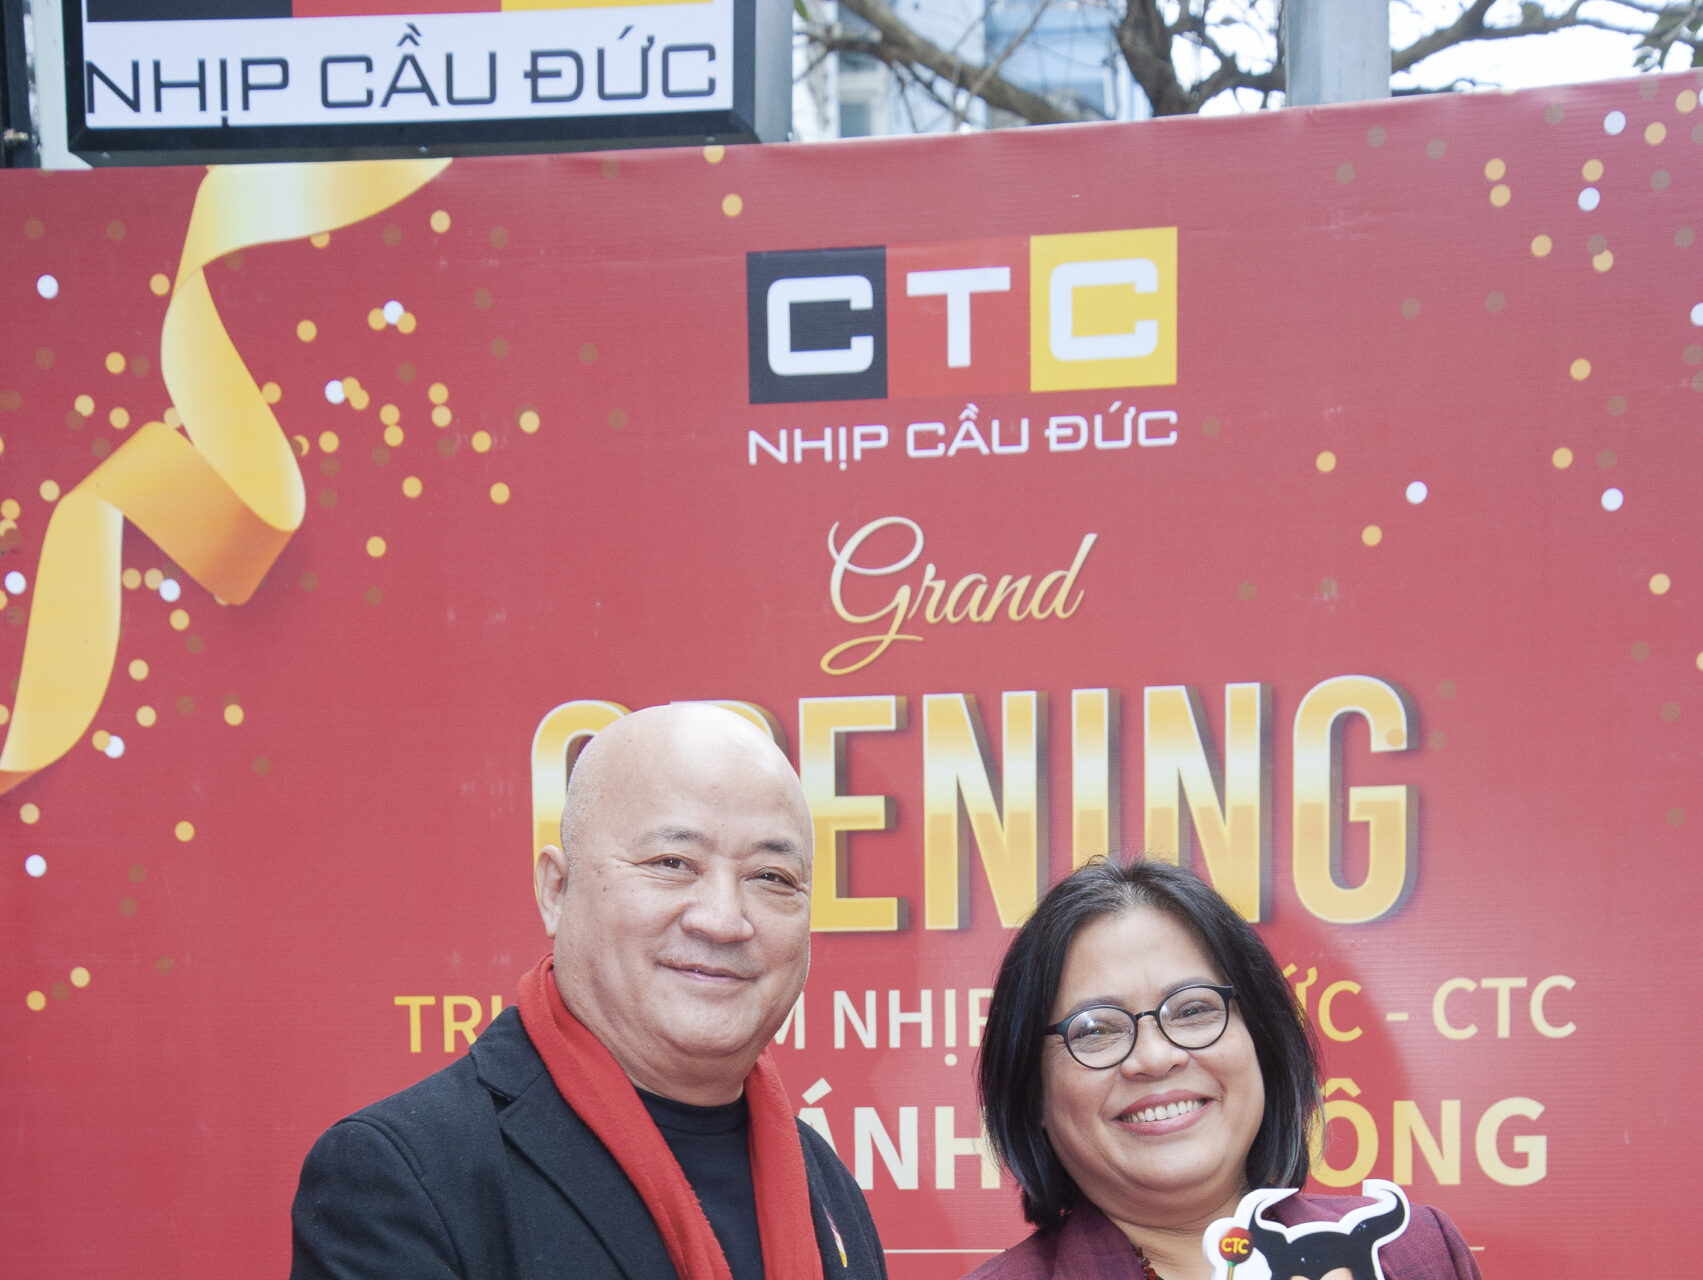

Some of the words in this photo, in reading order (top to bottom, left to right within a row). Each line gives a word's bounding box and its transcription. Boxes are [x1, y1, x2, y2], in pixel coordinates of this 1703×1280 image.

[86, 57, 289, 126] NHỊP
[321, 23, 497, 108] CẦU
[524, 25, 716, 104] ĐỨC
[767, 258, 1158, 376] CTC
[749, 424, 889, 470] NHỊP
[907, 403, 1029, 458] CẦU
[1045, 401, 1178, 452] ĐỨC
[820, 516, 1098, 675] Grand
[531, 675, 1418, 932] ENING
[1432, 975, 1577, 1040] CTC
[1305, 1078, 1547, 1187] ÔNG
[1222, 1237, 1249, 1254] CTC
